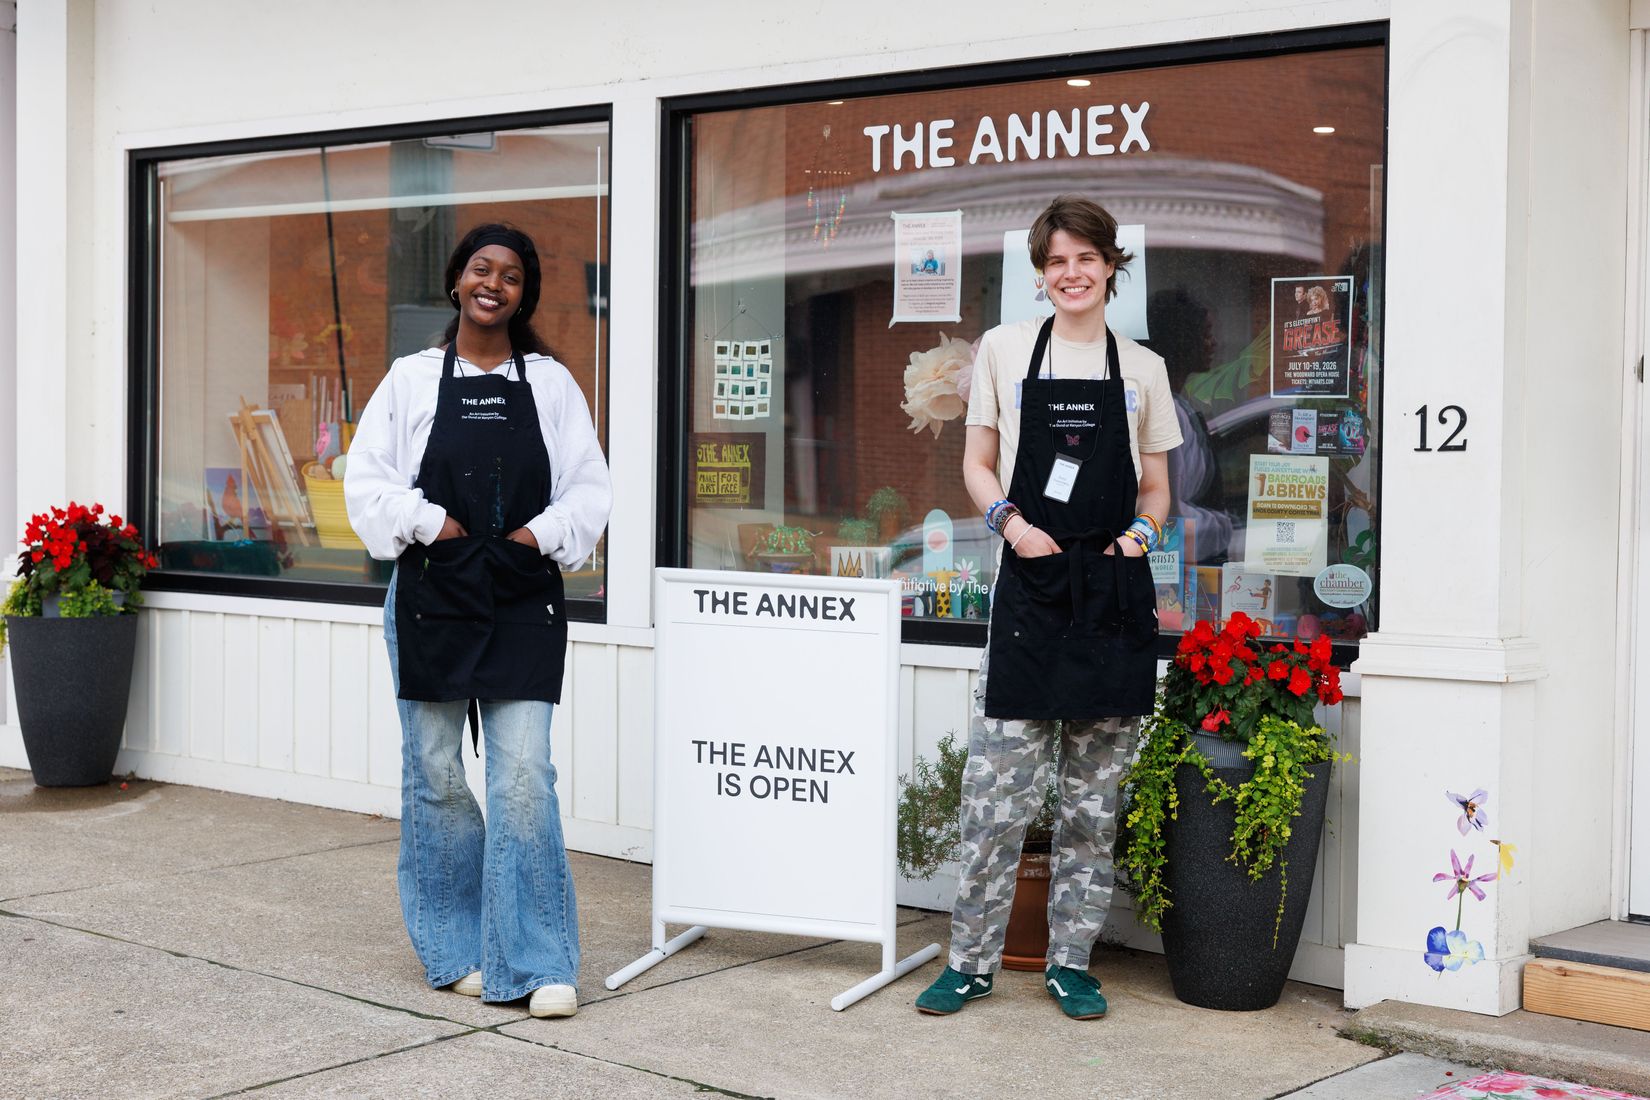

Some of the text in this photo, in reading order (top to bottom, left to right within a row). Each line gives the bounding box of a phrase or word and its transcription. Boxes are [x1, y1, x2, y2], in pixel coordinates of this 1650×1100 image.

[863, 101, 1152, 172] THE ANNEX
[1283, 319, 1341, 351] GREASE
[1288, 361, 1337, 371] JULY 10-19, 2026
[461, 396, 506, 406] THE ANNEX
[1048, 403, 1095, 411] THE ANNEX
[1413, 404, 1468, 452] 12
[700, 443, 750, 463] THE ANNEX
[720, 473, 738, 483] FOR
[1267, 473, 1327, 485] BACKROADS
[699, 483, 716, 493] ART
[720, 483, 738, 493] FREE
[1336, 570, 1348, 579] the
[949, 580, 964, 596] by
[966, 580, 989, 595] The
[1319, 576, 1365, 588] chamber
[693, 589, 856, 622] THE ANNEX
[691, 739, 856, 776] THE ANNEX
[716, 772, 829, 804] IS OPEN
